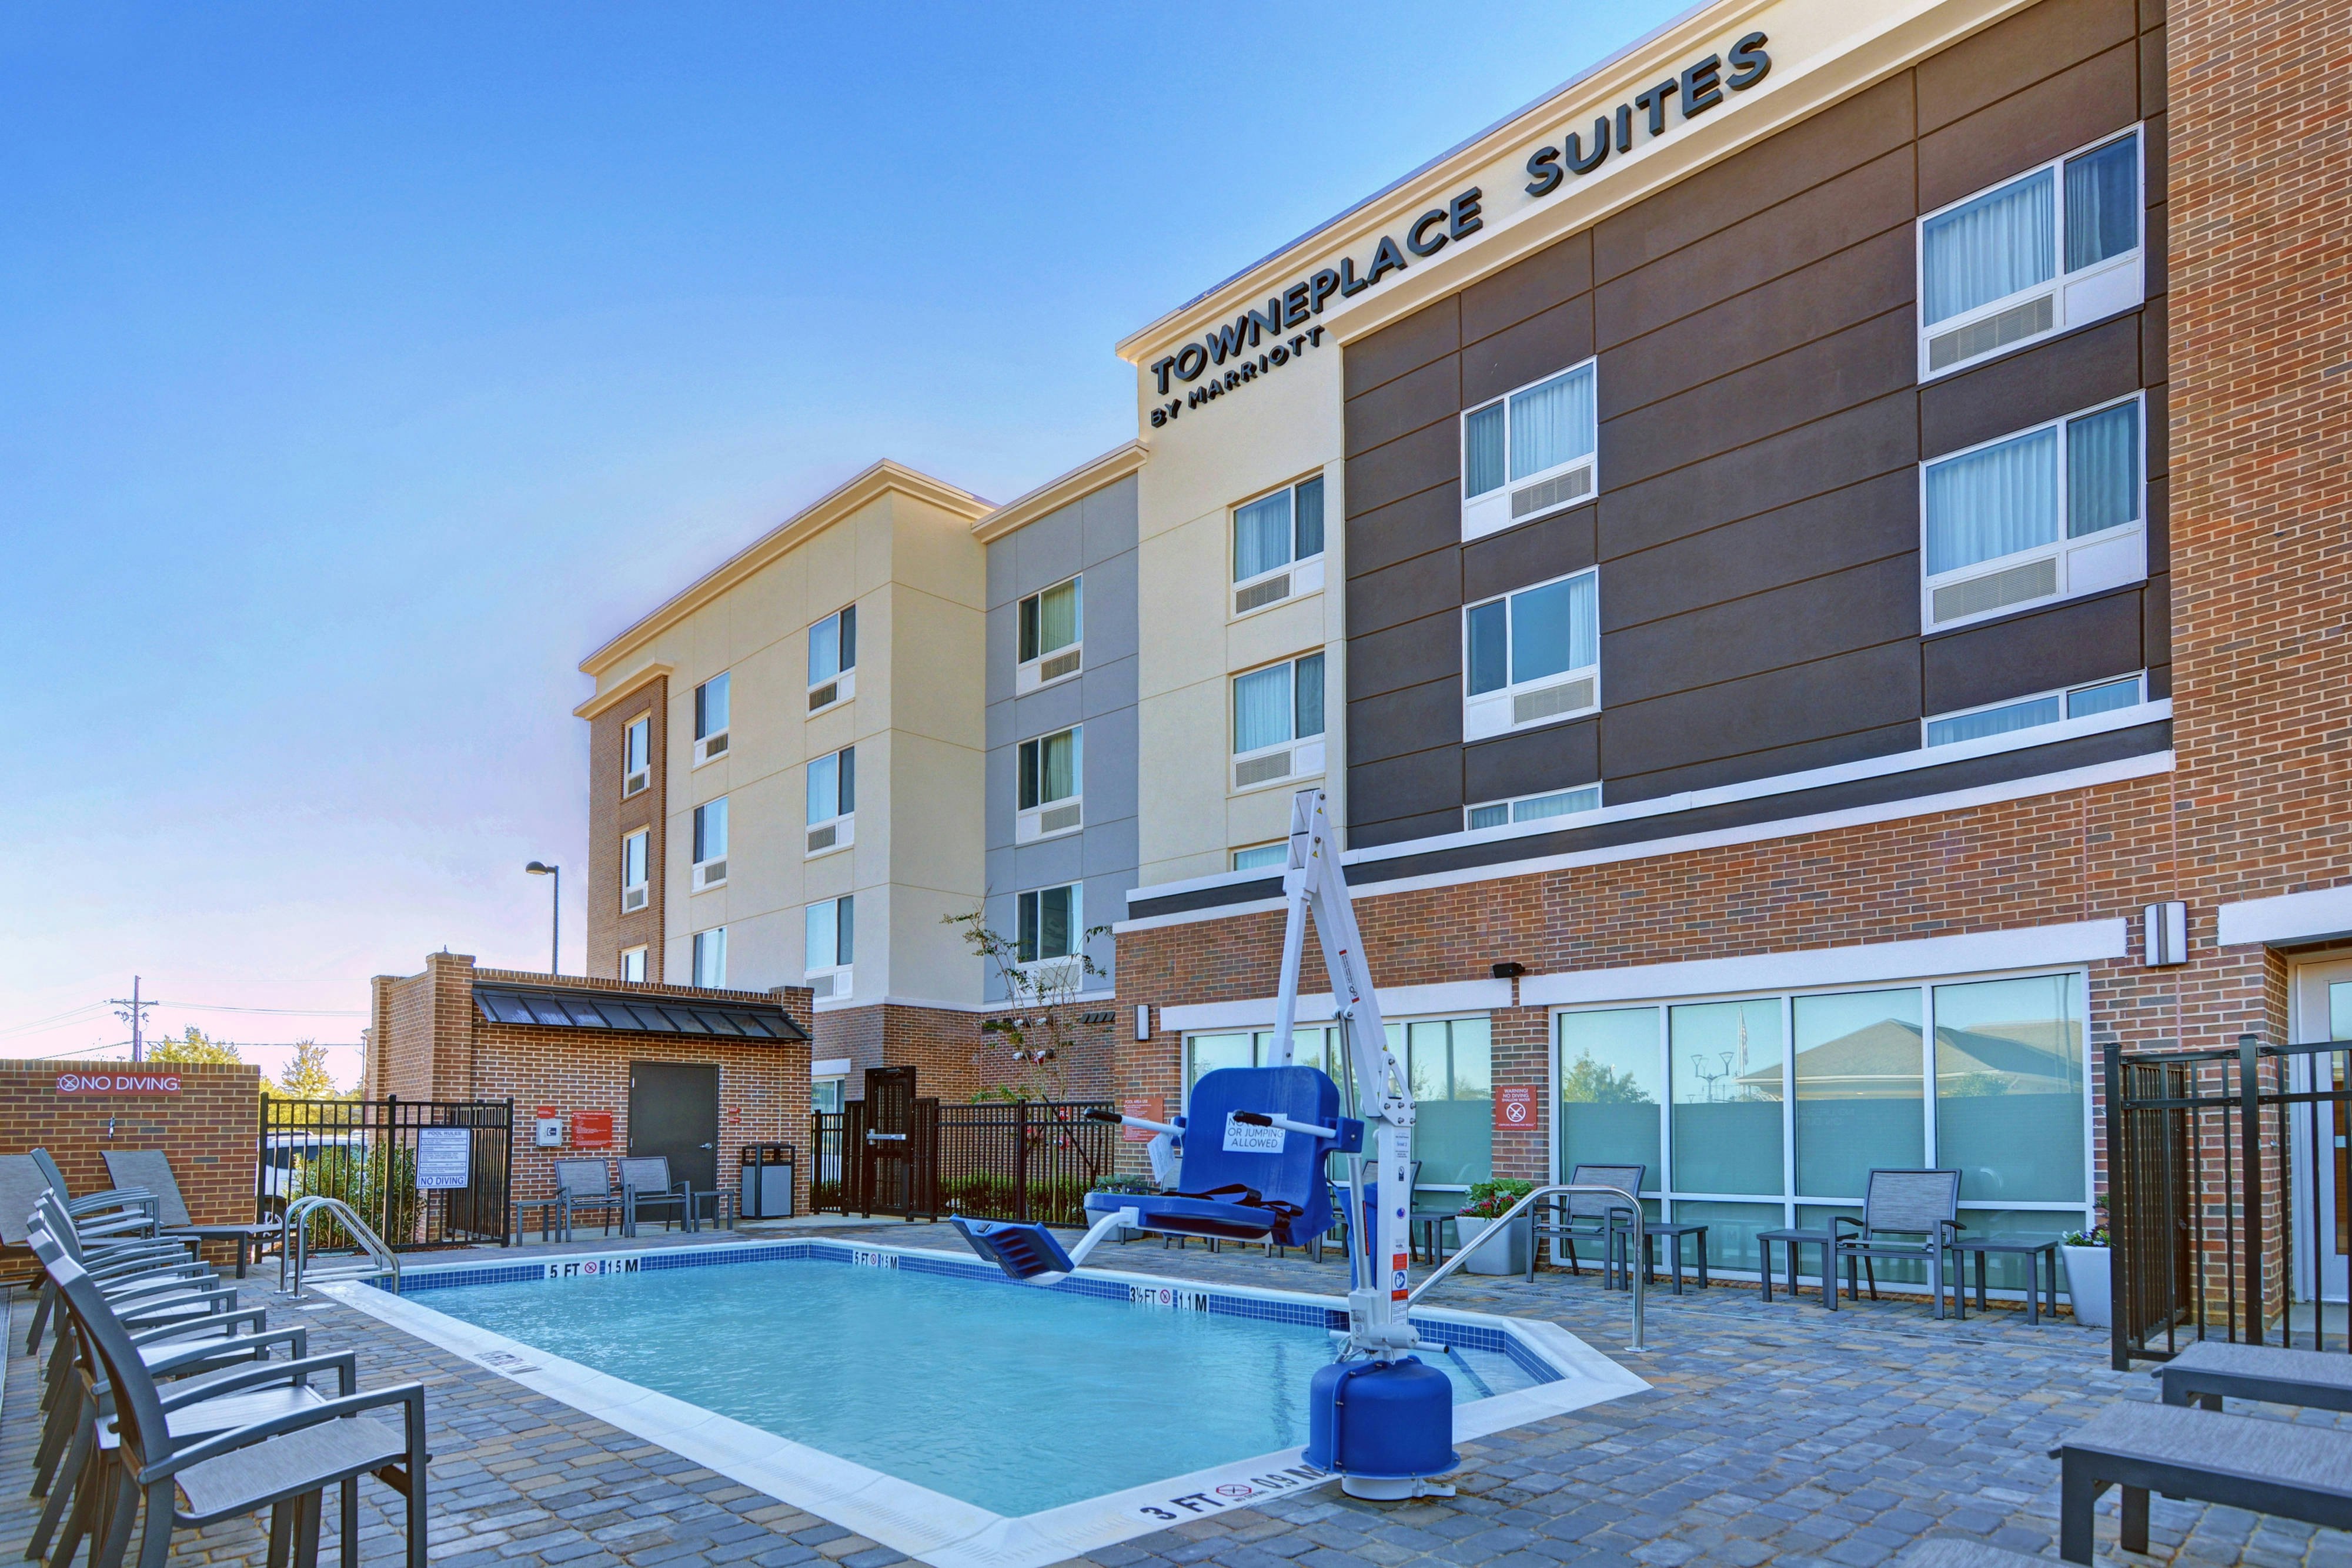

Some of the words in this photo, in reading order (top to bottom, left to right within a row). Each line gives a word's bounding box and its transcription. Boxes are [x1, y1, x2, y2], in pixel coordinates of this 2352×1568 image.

[1150, 186, 1483, 394] TOWNEPLACE
[1524, 31, 1771, 198] SUITES
[1150, 399, 1182, 428] BY
[1188, 325, 1325, 410] MARRIOTT
[81, 1076, 111, 1091] NO
[116, 1076, 178, 1091] DIVING
[1228, 1128, 1242, 1136] OR
[1244, 1128, 1284, 1138] JUMPING
[1231, 1138, 1278, 1148] ALLOWED
[420, 1177, 433, 1185] NO
[436, 1176, 464, 1185] DIVING
[625, 1259, 638, 1272] M
[855, 1251, 859, 1266] 5
[861, 1253, 868, 1266] FT
[890, 1256, 897, 1270] M
[550, 1264, 558, 1278] 5
[564, 1263, 580, 1278] FT
[1144, 1289, 1157, 1304] FT
[1180, 1291, 1191, 1310] 1.1
[1195, 1293, 1207, 1312] M
[1250, 1474, 1299, 1489] 0.9
[1282, 1464, 1327, 1481] M
[1140, 1507, 1177, 1520] 3
[1169, 1493, 1225, 1513] FT
